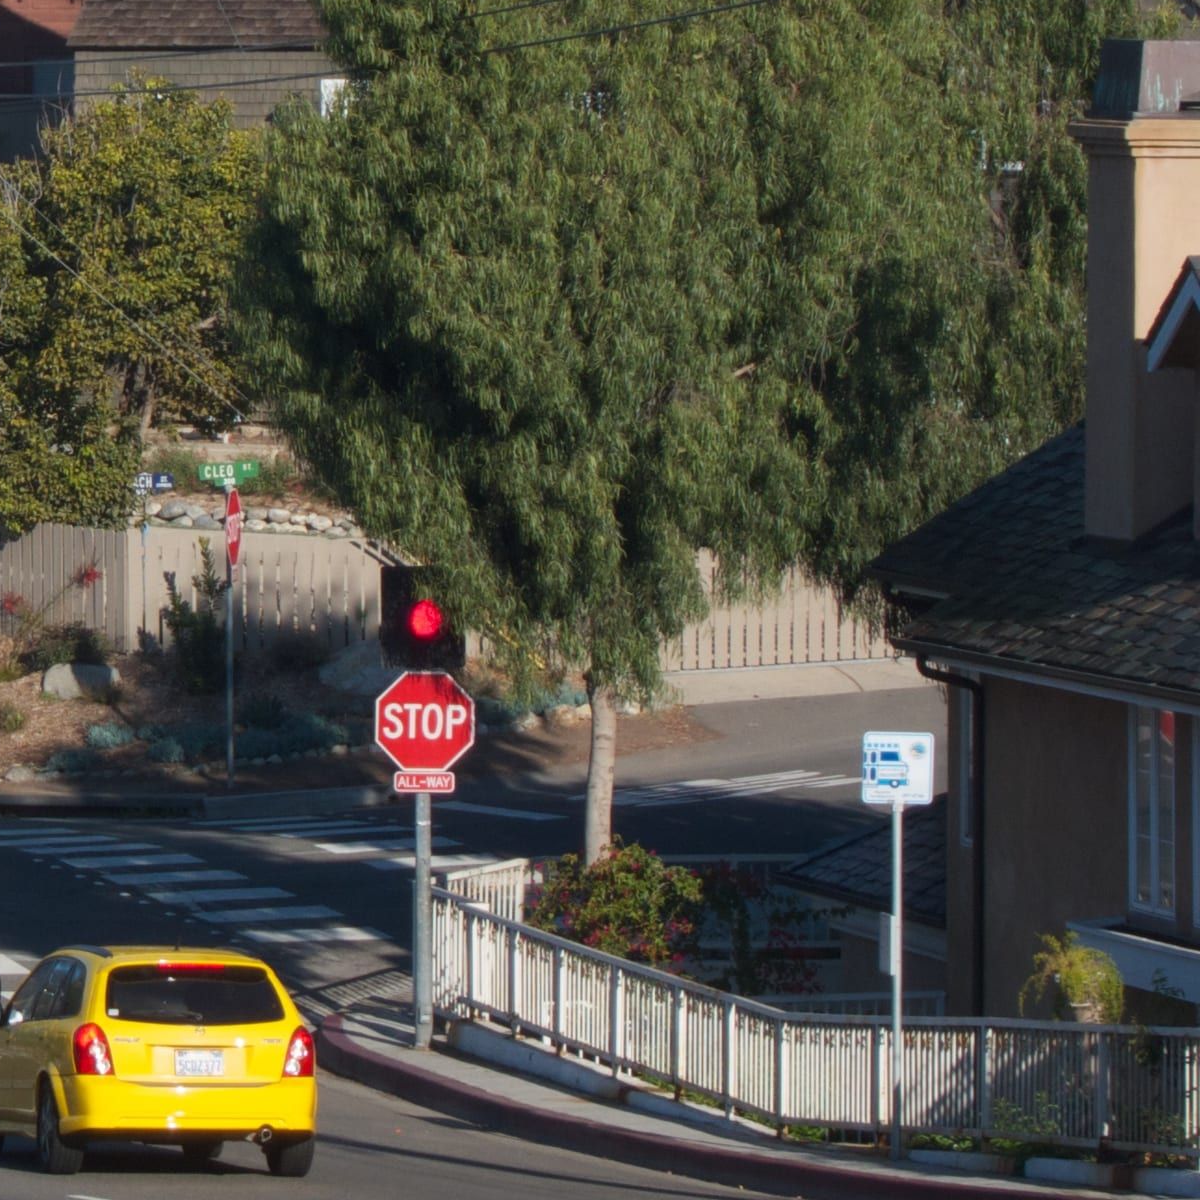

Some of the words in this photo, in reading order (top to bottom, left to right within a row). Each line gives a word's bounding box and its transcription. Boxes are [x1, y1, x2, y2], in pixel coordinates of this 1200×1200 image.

[204, 464, 234, 479] CLEO
[383, 703, 467, 740] STOP
[397, 776, 451, 788] ALL-WAY
